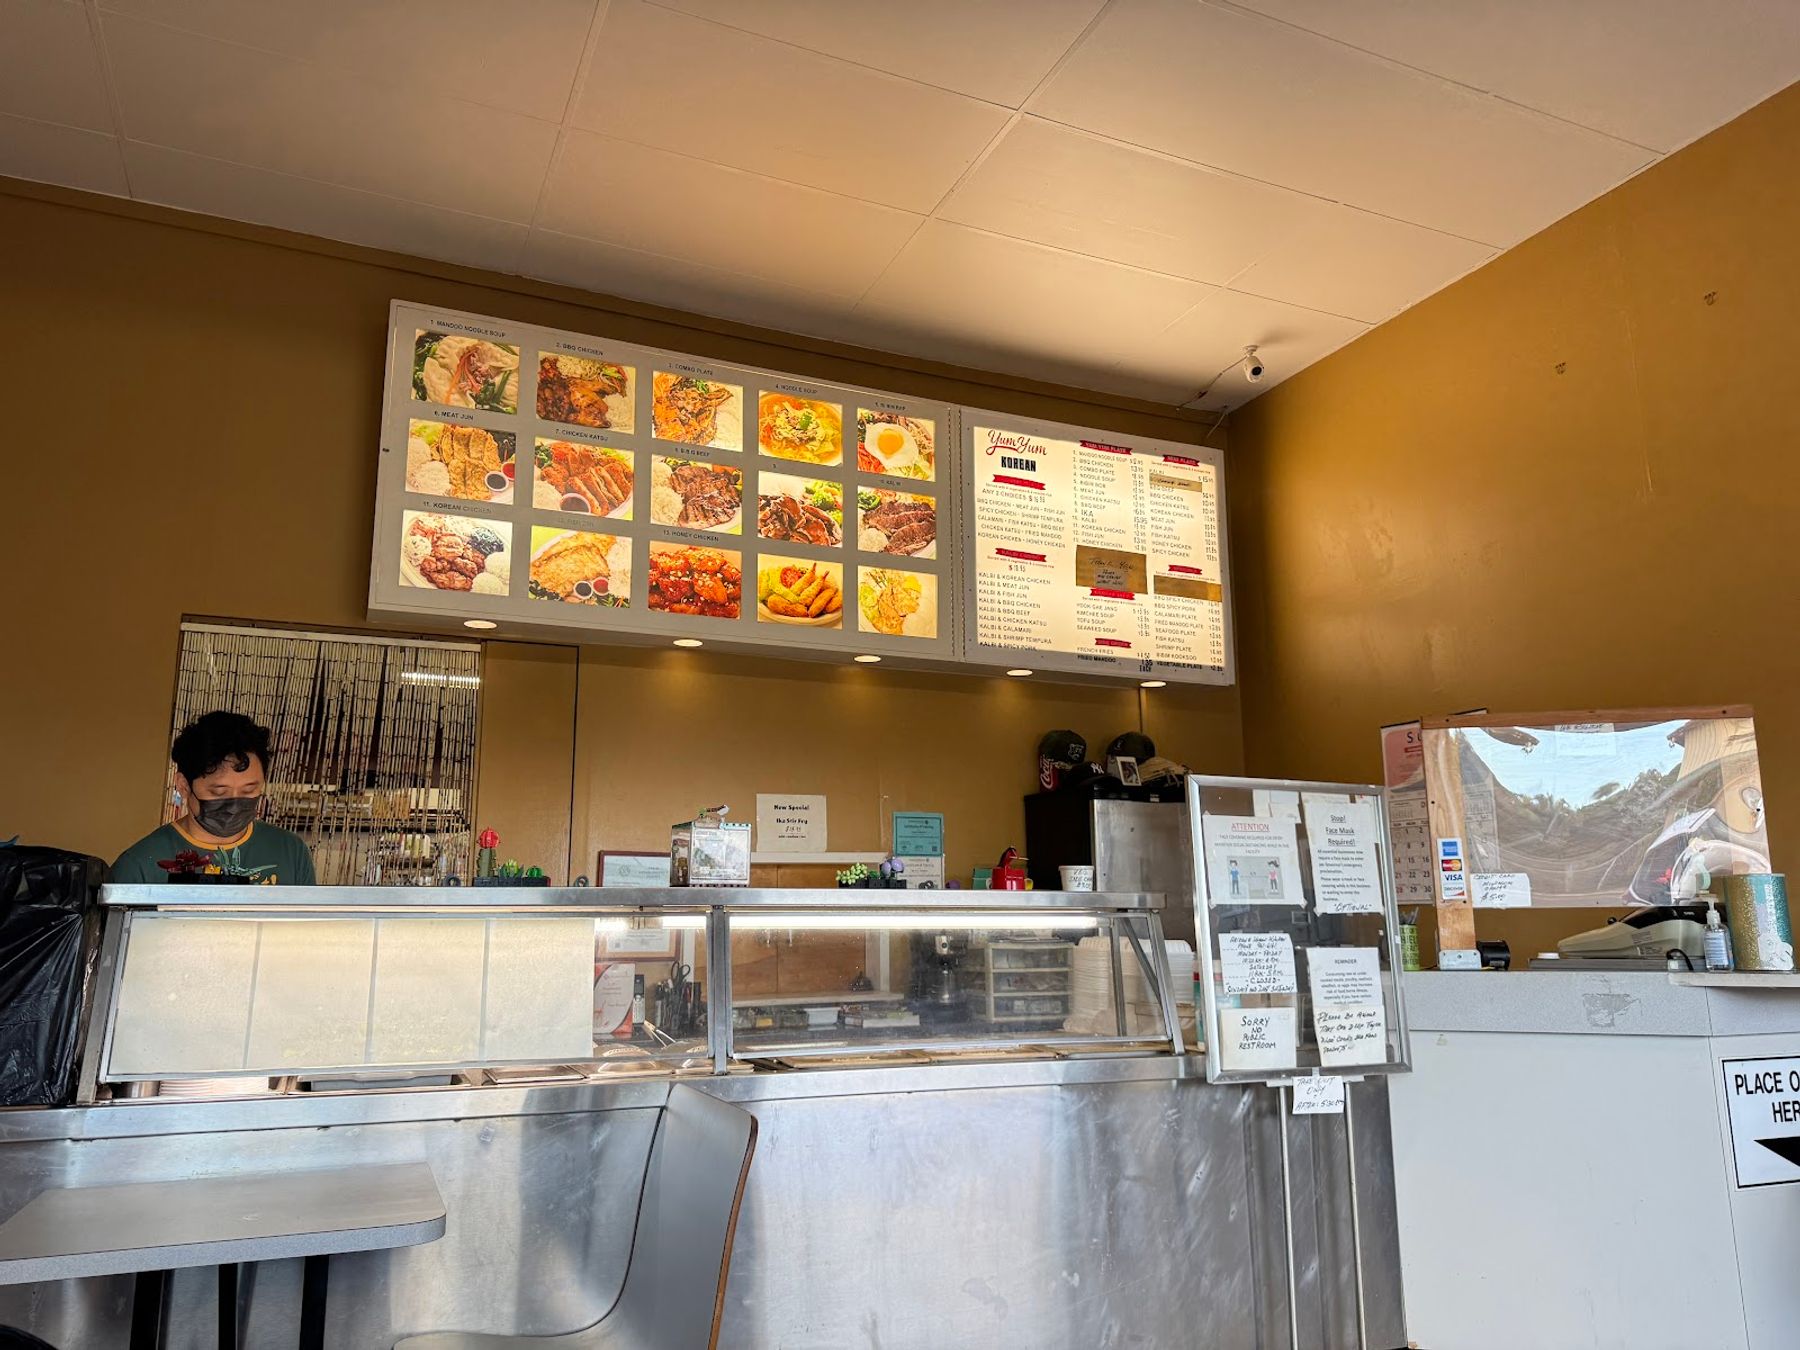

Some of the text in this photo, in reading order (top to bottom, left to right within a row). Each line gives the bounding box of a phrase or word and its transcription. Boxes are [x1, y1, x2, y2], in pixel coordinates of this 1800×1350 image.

[437, 321, 506, 338] MANDOO NOODLE SOUP
[577, 346, 603, 356] CHICKEN
[675, 363, 713, 376] COMBO PLATE
[441, 411, 459, 419] MEAT
[562, 429, 608, 442] CHICKEN KATSU
[986, 429, 1047, 456] Yum Yum
[1001, 456, 1036, 472] KOREAN
[1092, 460, 1114, 468] CHICKEN
[1001, 490, 1027, 500] CHOICES
[433, 502, 461, 511] KOREAN
[989, 499, 1011, 508] CHICKEN
[977, 515, 1004, 523] CALAMARI
[1041, 515, 1064, 523] TEMPURA
[981, 524, 1004, 532] CHICKEN
[1004, 526, 1021, 534] KATSU
[1041, 531, 1062, 539] MANDOO
[1044, 540, 1066, 548] CHICKEN
[1154, 611, 1180, 619] CALAMARI
[1003, 617, 1027, 625] CHICKEN
[1231, 823, 1270, 831] ATTENTION
[1328, 838, 1355, 846] Required!
[1241, 1015, 1270, 1028] SORRY
[1238, 1042, 1276, 1050] RESTROOM
[1735, 1072, 1783, 1095] PLACE
